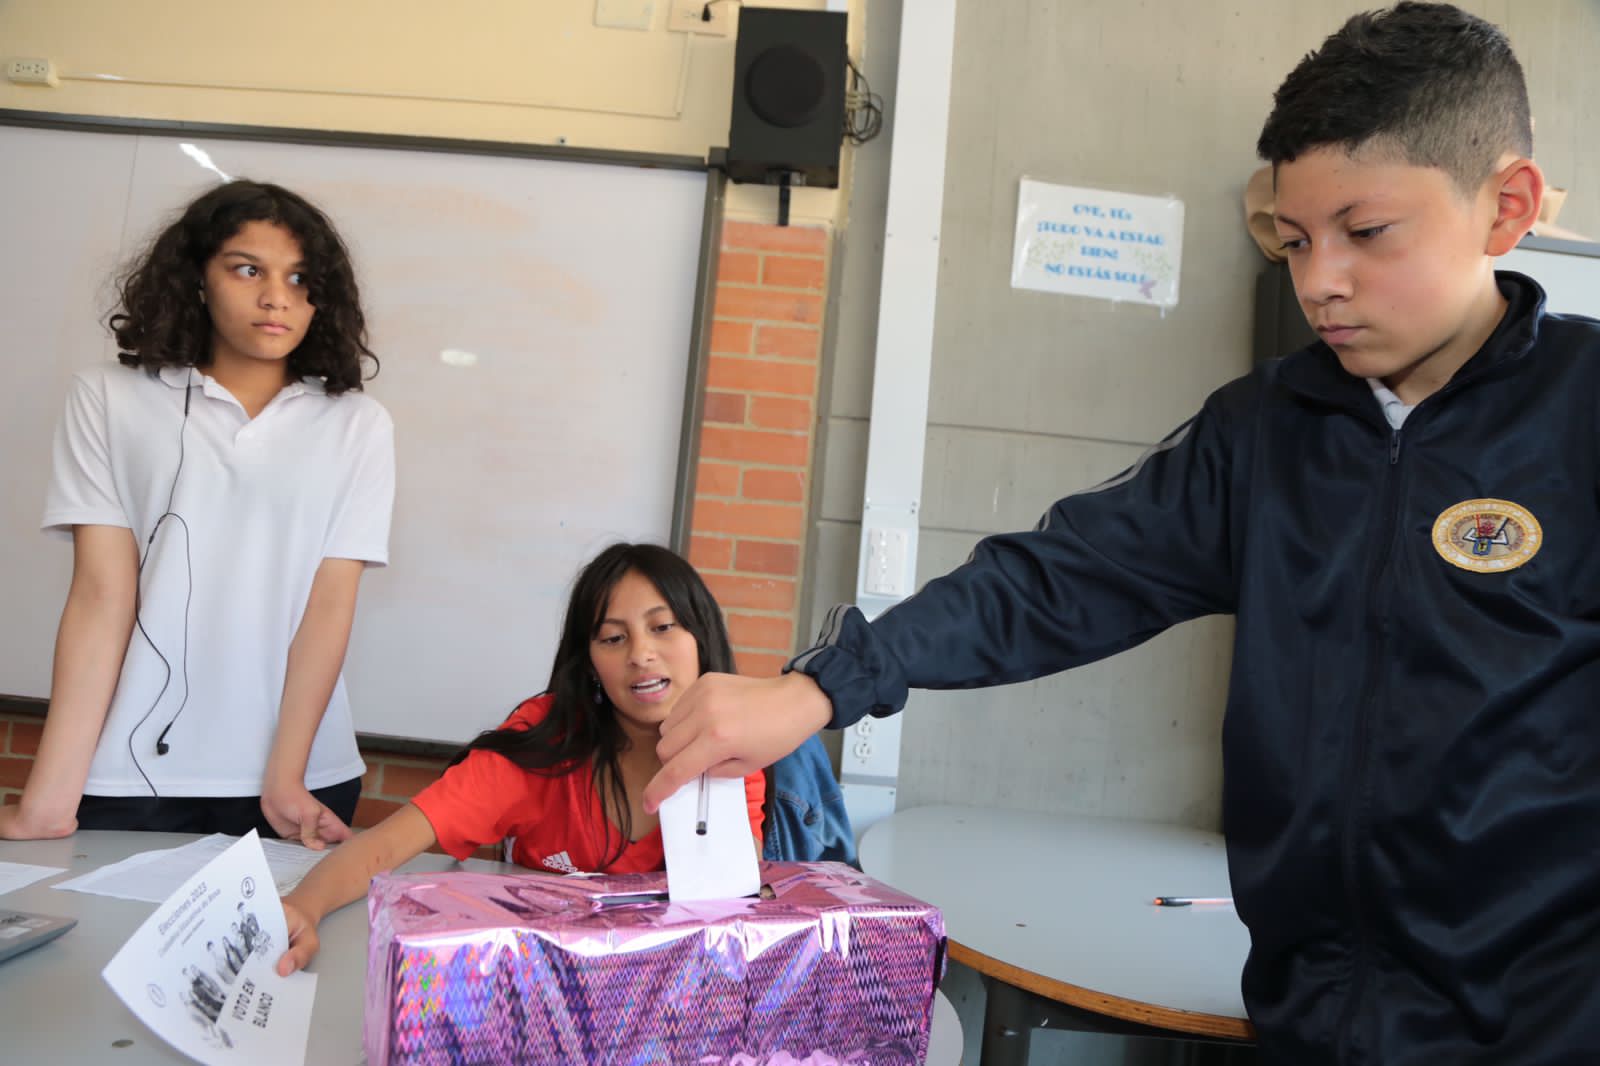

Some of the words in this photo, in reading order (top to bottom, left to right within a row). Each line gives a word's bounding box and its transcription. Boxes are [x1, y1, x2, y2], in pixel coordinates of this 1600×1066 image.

[1083, 226, 1104, 239] VA
[1107, 230, 1117, 240] A
[1119, 231, 1165, 246] ESTAR
[1044, 263, 1065, 276] NO
[542, 858, 578, 873] adidas
[158, 897, 192, 936] Elecciones
[190, 881, 208, 901] 2023
[232, 992, 251, 1021] VOTO
[244, 977, 256, 997] EN
[253, 992, 273, 1028] BLANCO
